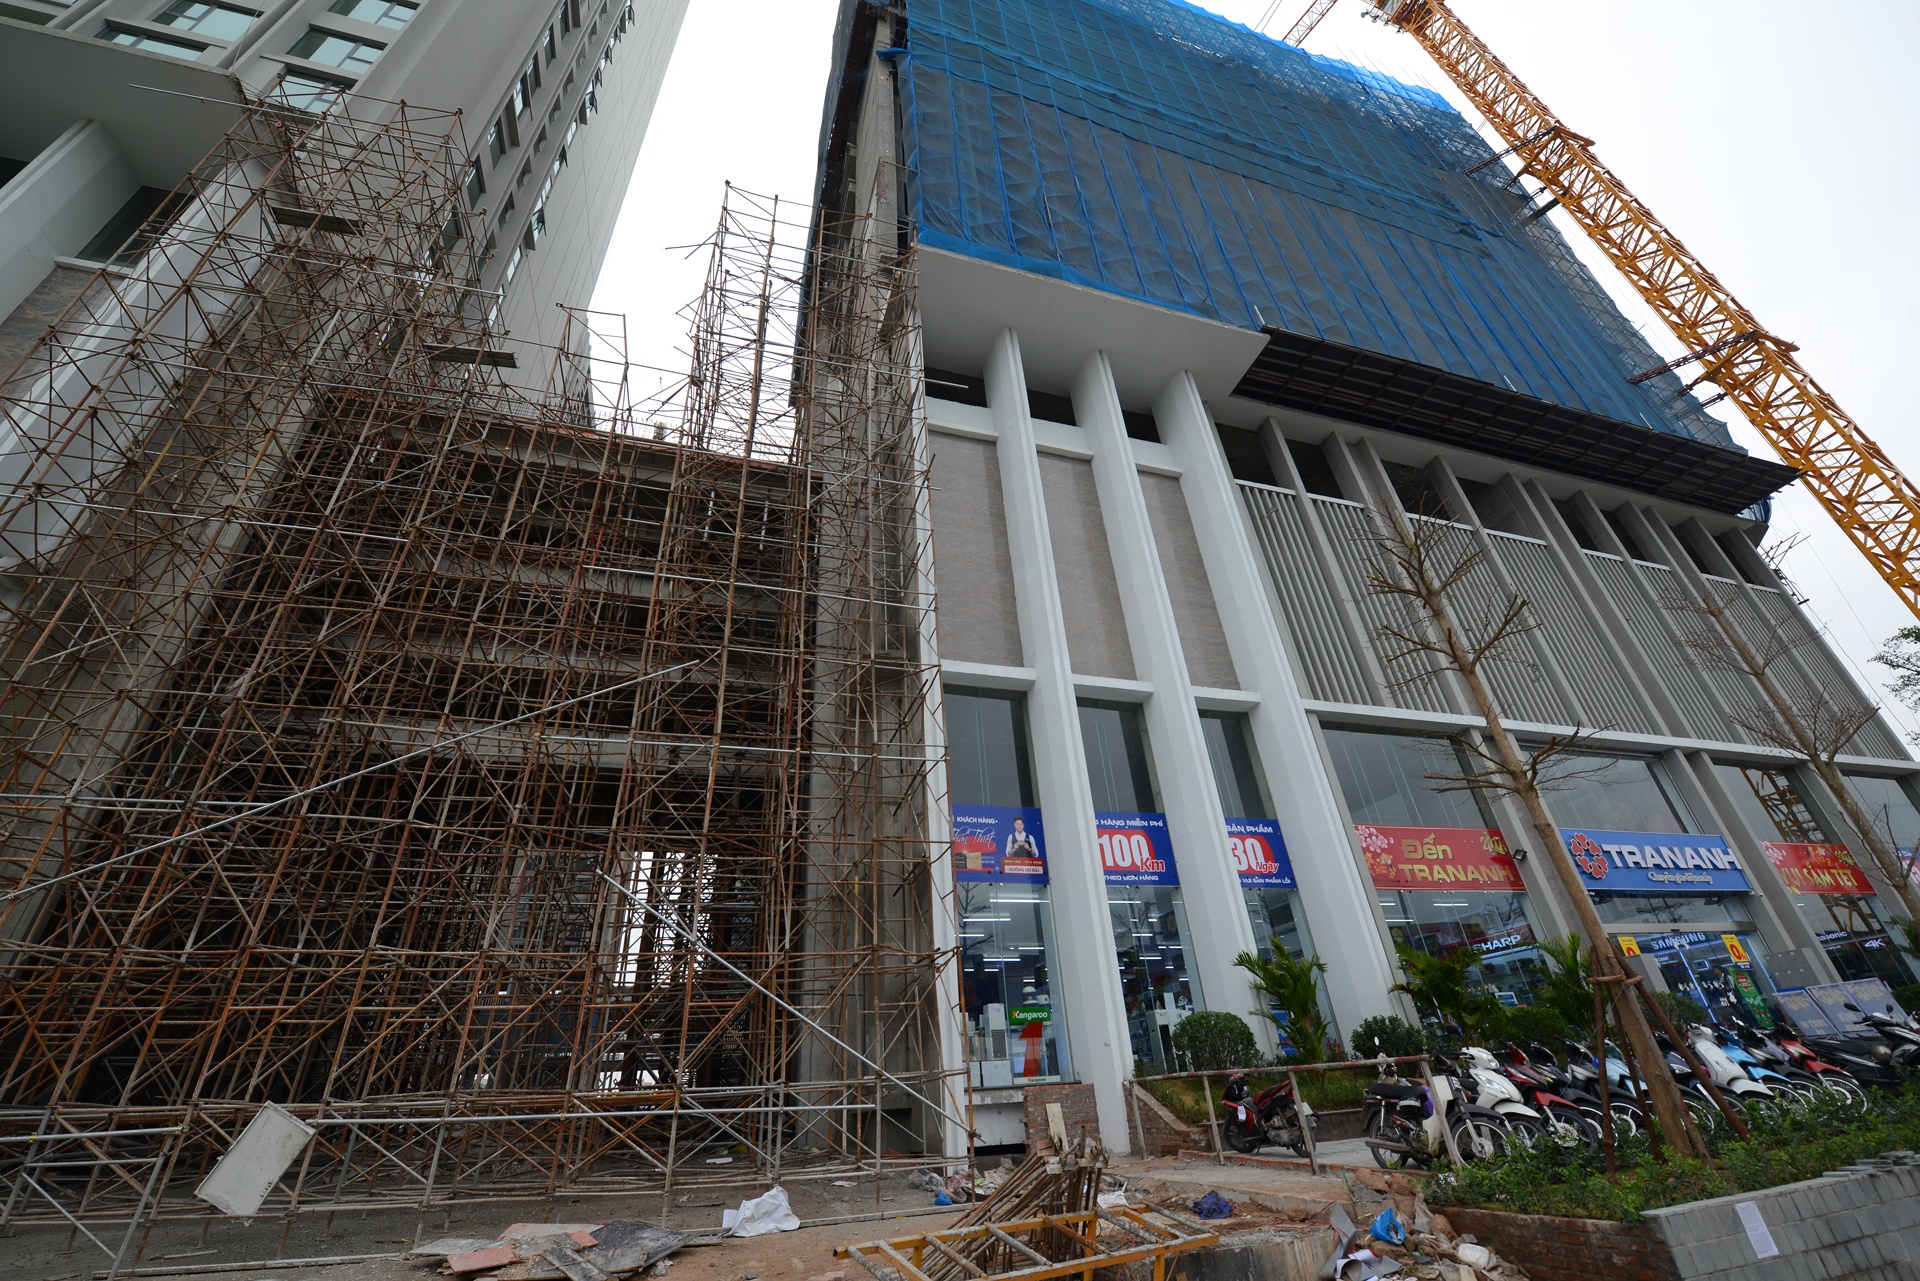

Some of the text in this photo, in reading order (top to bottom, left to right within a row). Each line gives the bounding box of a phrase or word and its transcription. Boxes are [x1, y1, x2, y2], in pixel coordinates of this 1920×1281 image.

[978, 816, 995, 824] HÀNG
[1101, 818, 1124, 826] HÀNG
[1127, 818, 1148, 826] MIỄN
[1150, 819, 1163, 827] PHÍ
[1246, 823, 1273, 833] PHẨM
[1098, 834, 1150, 867] 100
[1229, 838, 1265, 871] 30
[1401, 833, 1454, 860] Đến
[1140, 856, 1165, 872] Km
[1601, 844, 1743, 870] TRANANH
[1255, 861, 1279, 873] Ngày
[1398, 864, 1515, 882] TRANANH
[1803, 861, 1836, 886] SẮM
[1830, 862, 1858, 886] TẾT
[1864, 938, 1887, 948] 4K
[1012, 1011, 1048, 1020] Kangaroo
